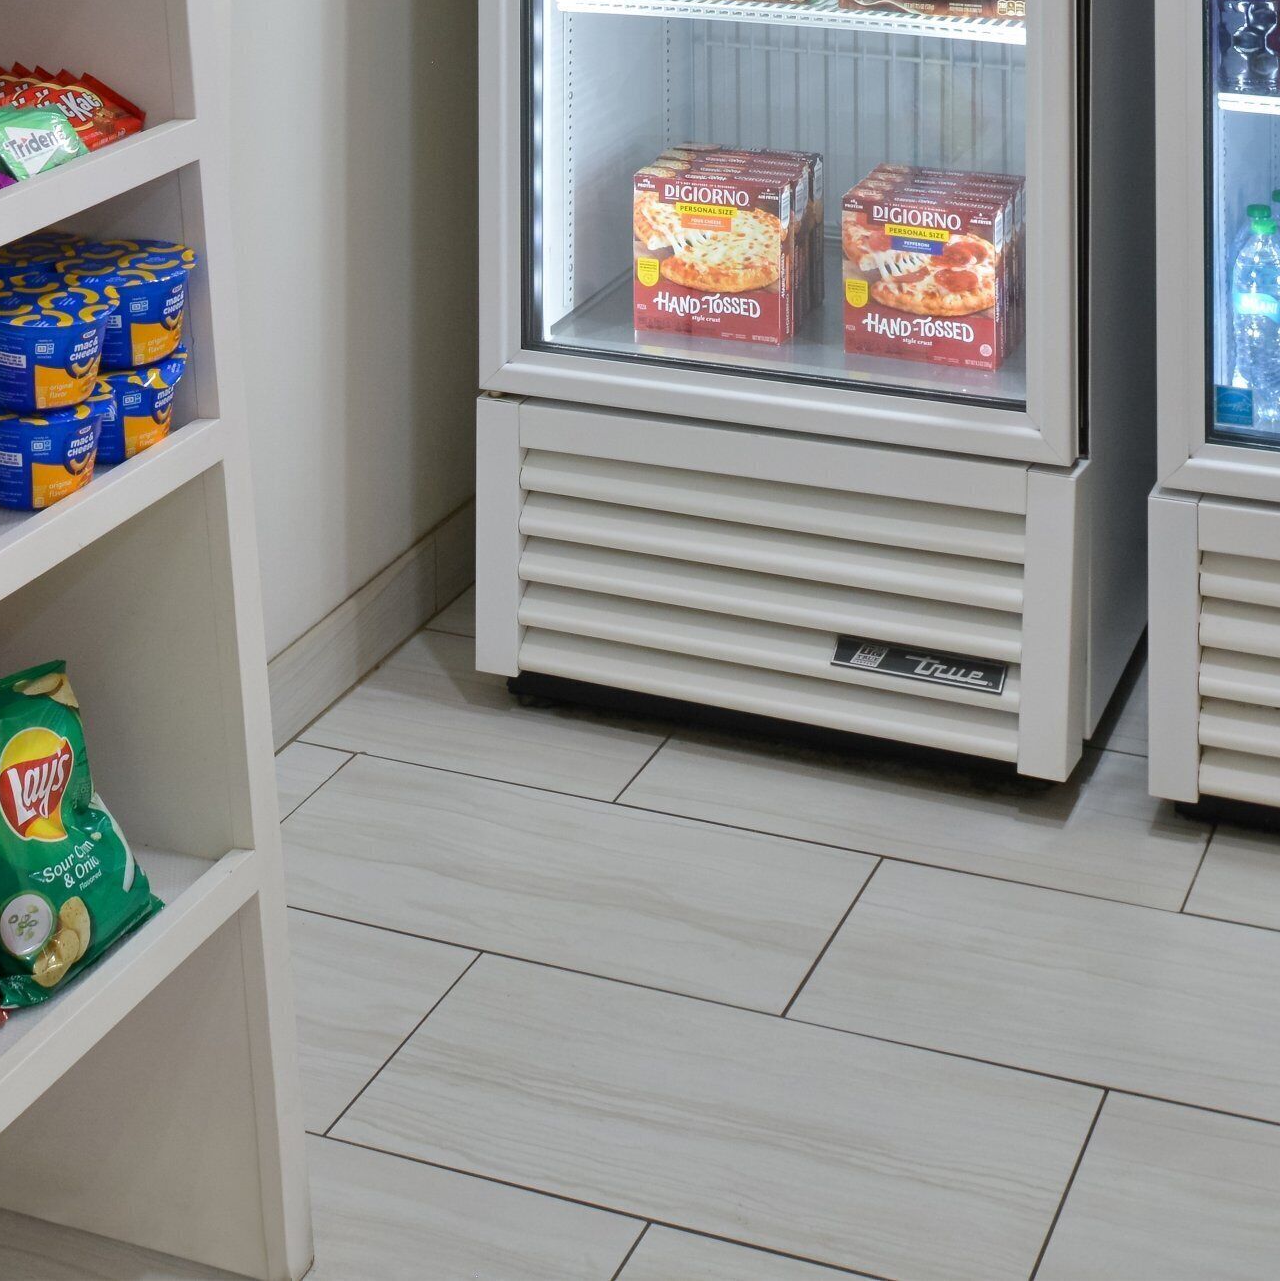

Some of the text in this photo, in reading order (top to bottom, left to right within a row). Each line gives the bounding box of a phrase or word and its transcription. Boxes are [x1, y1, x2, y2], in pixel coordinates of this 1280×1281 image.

[680, 206, 734, 216] PERSONAL SIZE
[889, 226, 945, 239] PERSONAL SIZE
[903, 240, 930, 248] PEPPERONI
[653, 291, 761, 319] HAND-TOSSED
[862, 313, 974, 343] HAND-TOSSED
[903, 337, 917, 345] style
[69, 347, 99, 363] CHEESE
[48, 390, 68, 399] flavor
[49, 383, 74, 392] original
[67, 442, 94, 458] CHEESE
[905, 655, 989, 686] true
[6, 748, 70, 827] Lay's
[79, 869, 102, 892] Flavored
